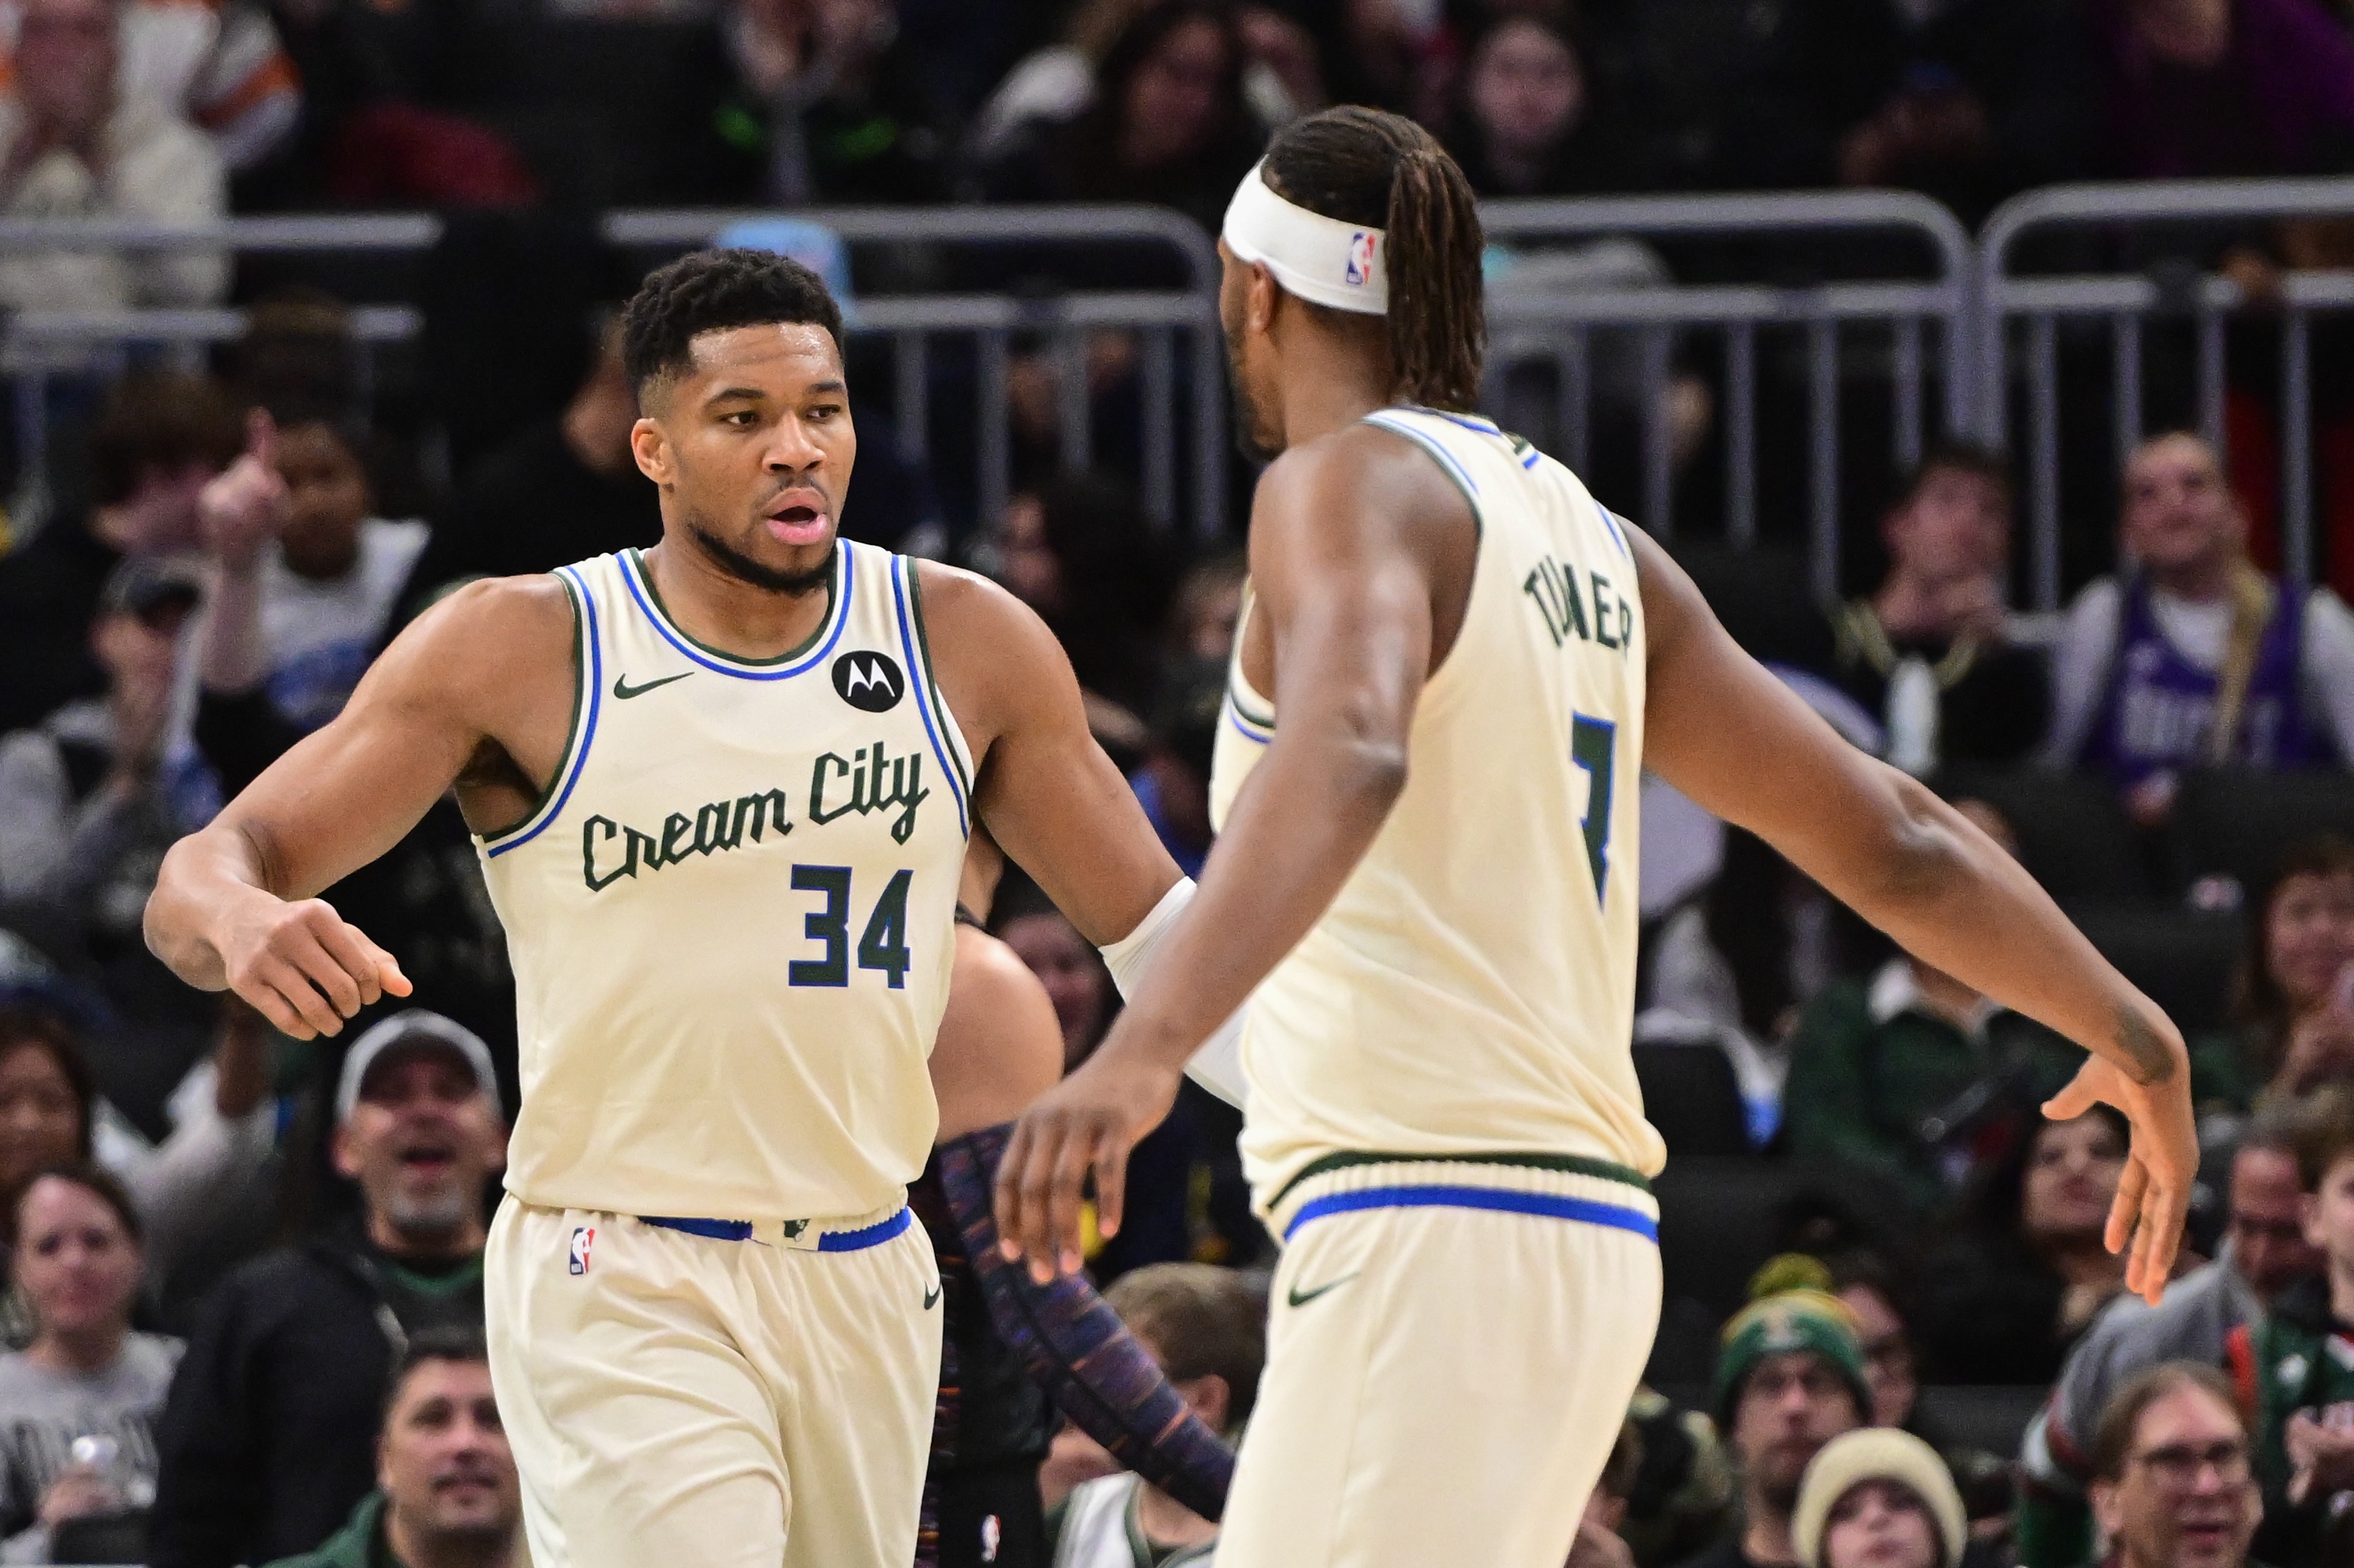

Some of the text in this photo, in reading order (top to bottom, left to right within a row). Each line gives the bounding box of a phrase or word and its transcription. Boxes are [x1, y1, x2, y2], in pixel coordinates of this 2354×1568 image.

[583, 740, 931, 893] Cream City
[788, 863, 915, 989] 34
